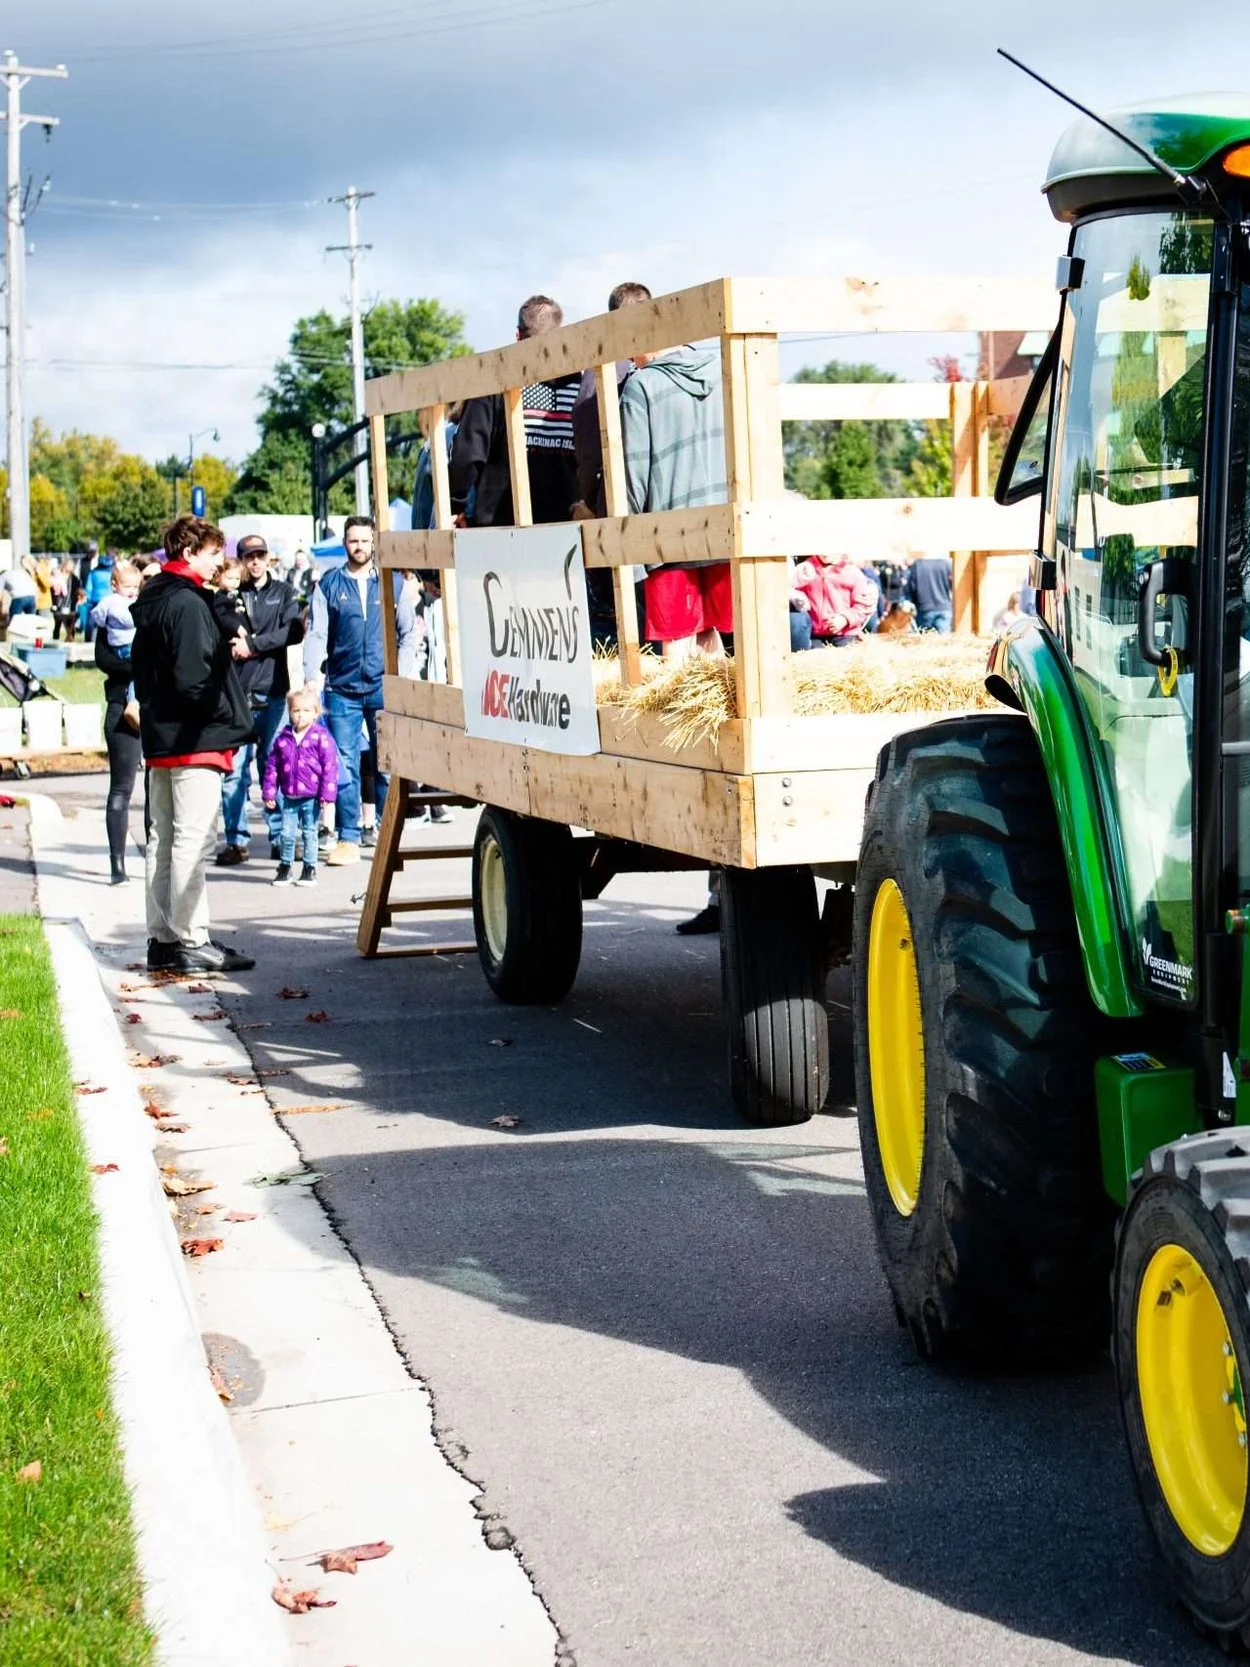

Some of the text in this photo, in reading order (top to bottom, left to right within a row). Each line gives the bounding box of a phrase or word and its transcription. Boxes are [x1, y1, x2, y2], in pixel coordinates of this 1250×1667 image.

[526, 436, 561, 448] ACKINAC
[508, 676, 571, 729] Hardware
[1149, 955, 1192, 980] GREENMARK
